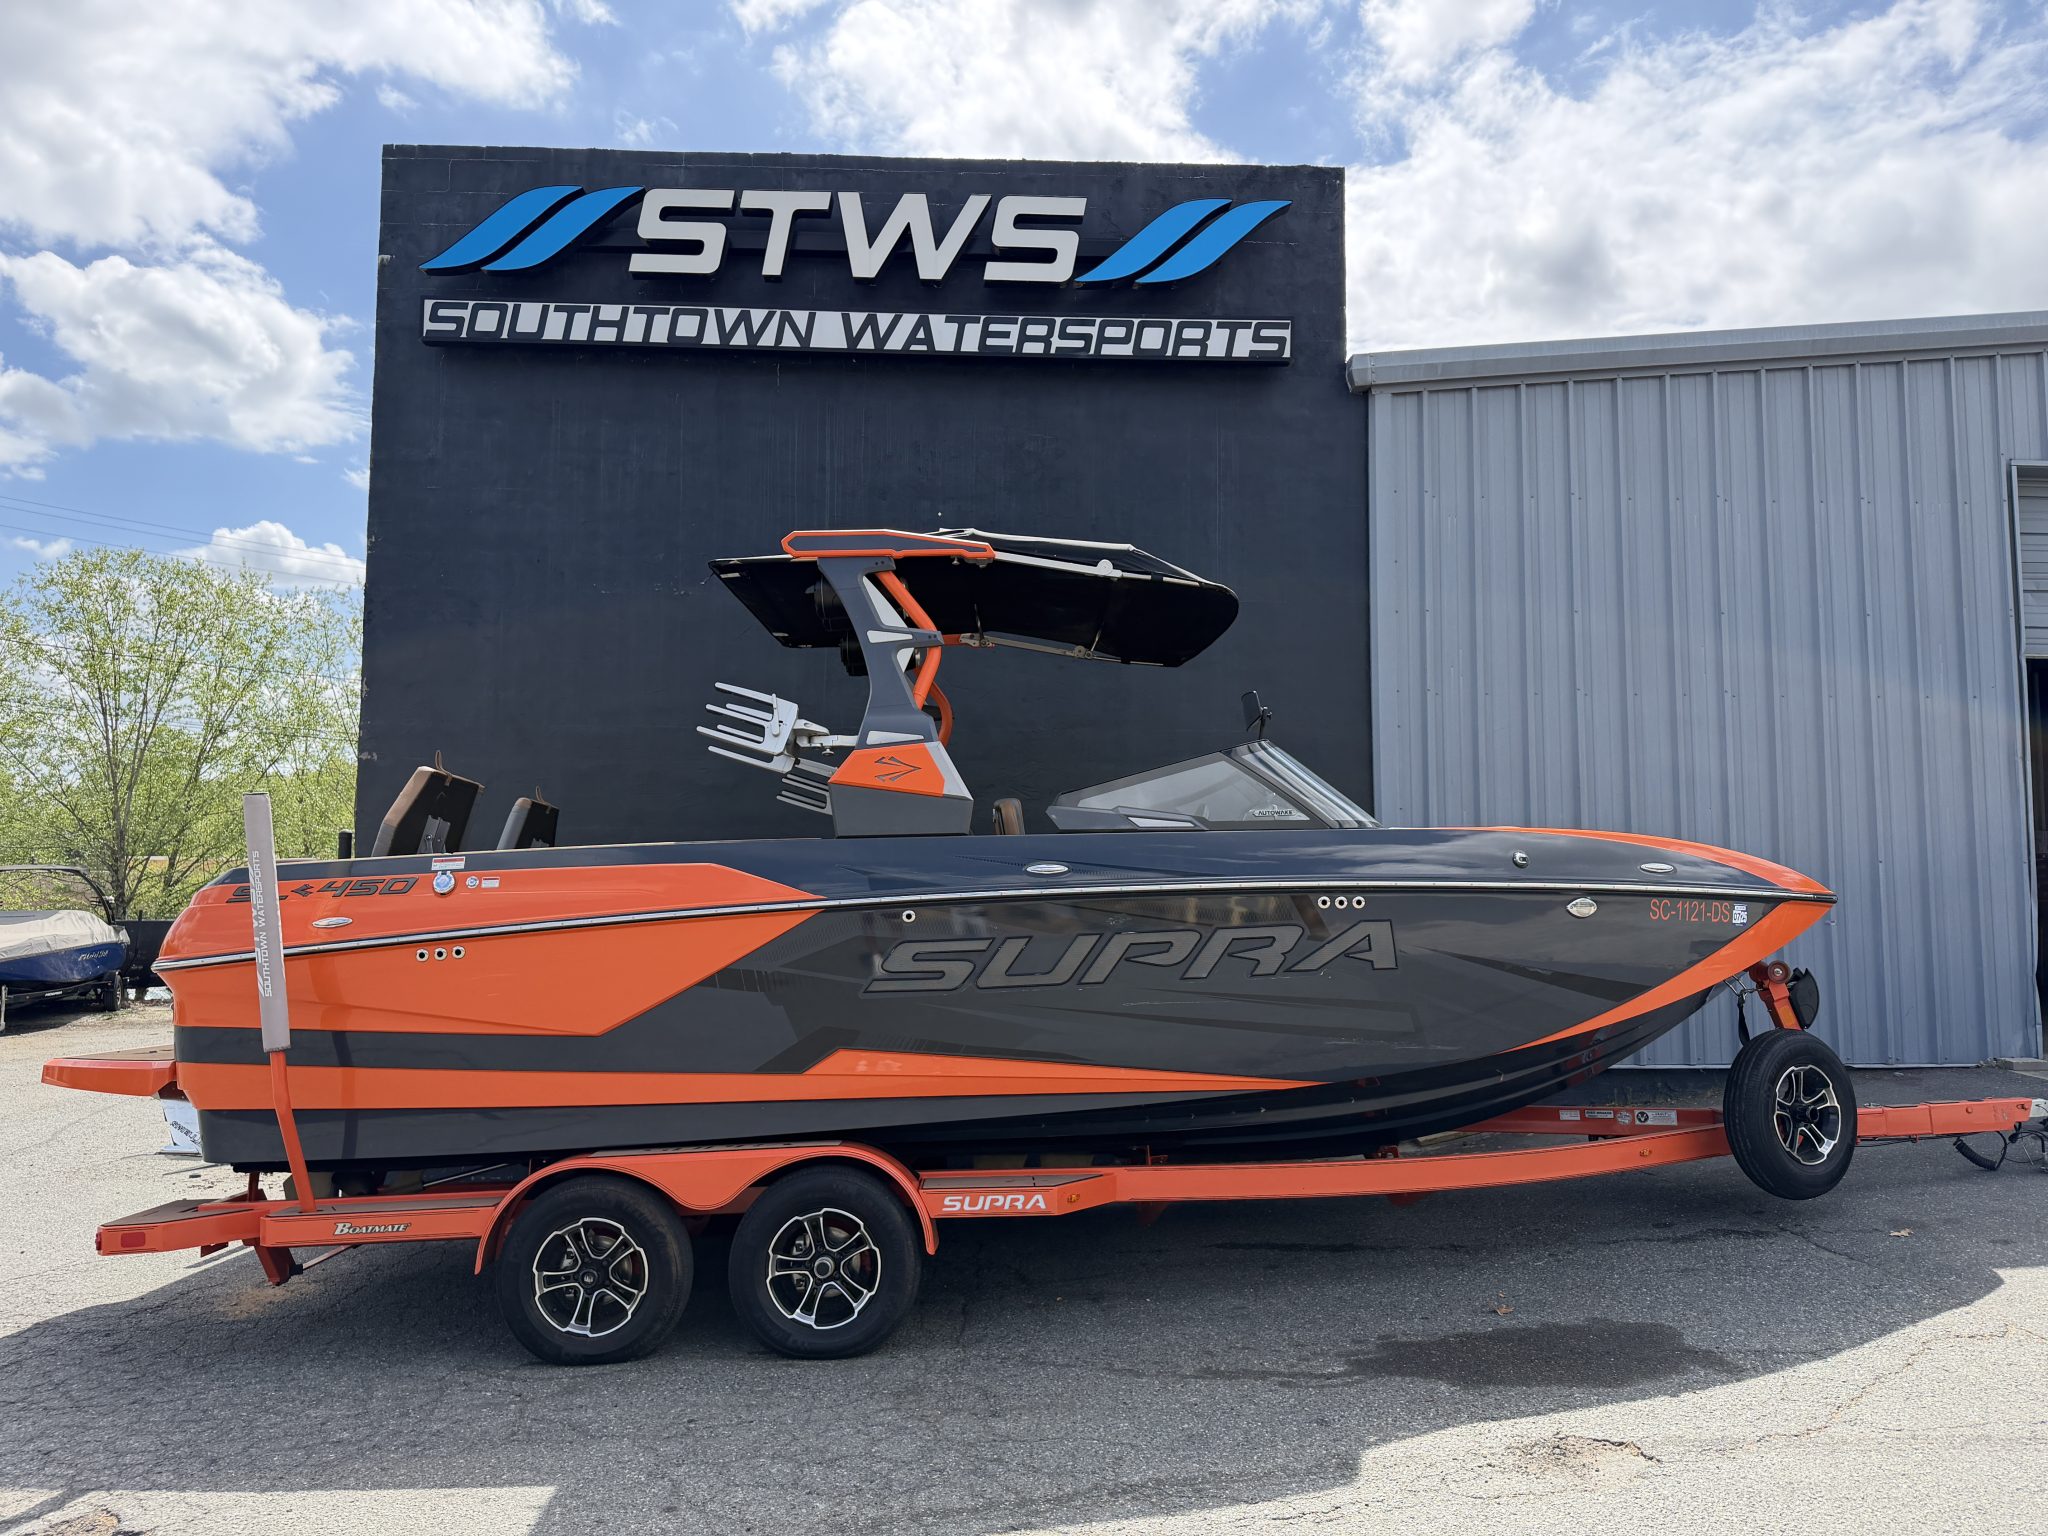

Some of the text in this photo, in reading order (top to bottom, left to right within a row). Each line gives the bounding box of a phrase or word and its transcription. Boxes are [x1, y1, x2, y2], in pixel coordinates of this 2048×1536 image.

[629, 188, 1087, 282] STWS
[428, 301, 1291, 358] SOUTHTOWN WATERSPORTS
[253, 850, 266, 928] WATERSPORTS
[317, 877, 419, 898] 450
[1650, 898, 1730, 922] SC-1121-DS
[260, 931, 273, 997] SOUTHTOWN
[862, 919, 1399, 993] SUPRA
[942, 1194, 1047, 1211] SUPRA
